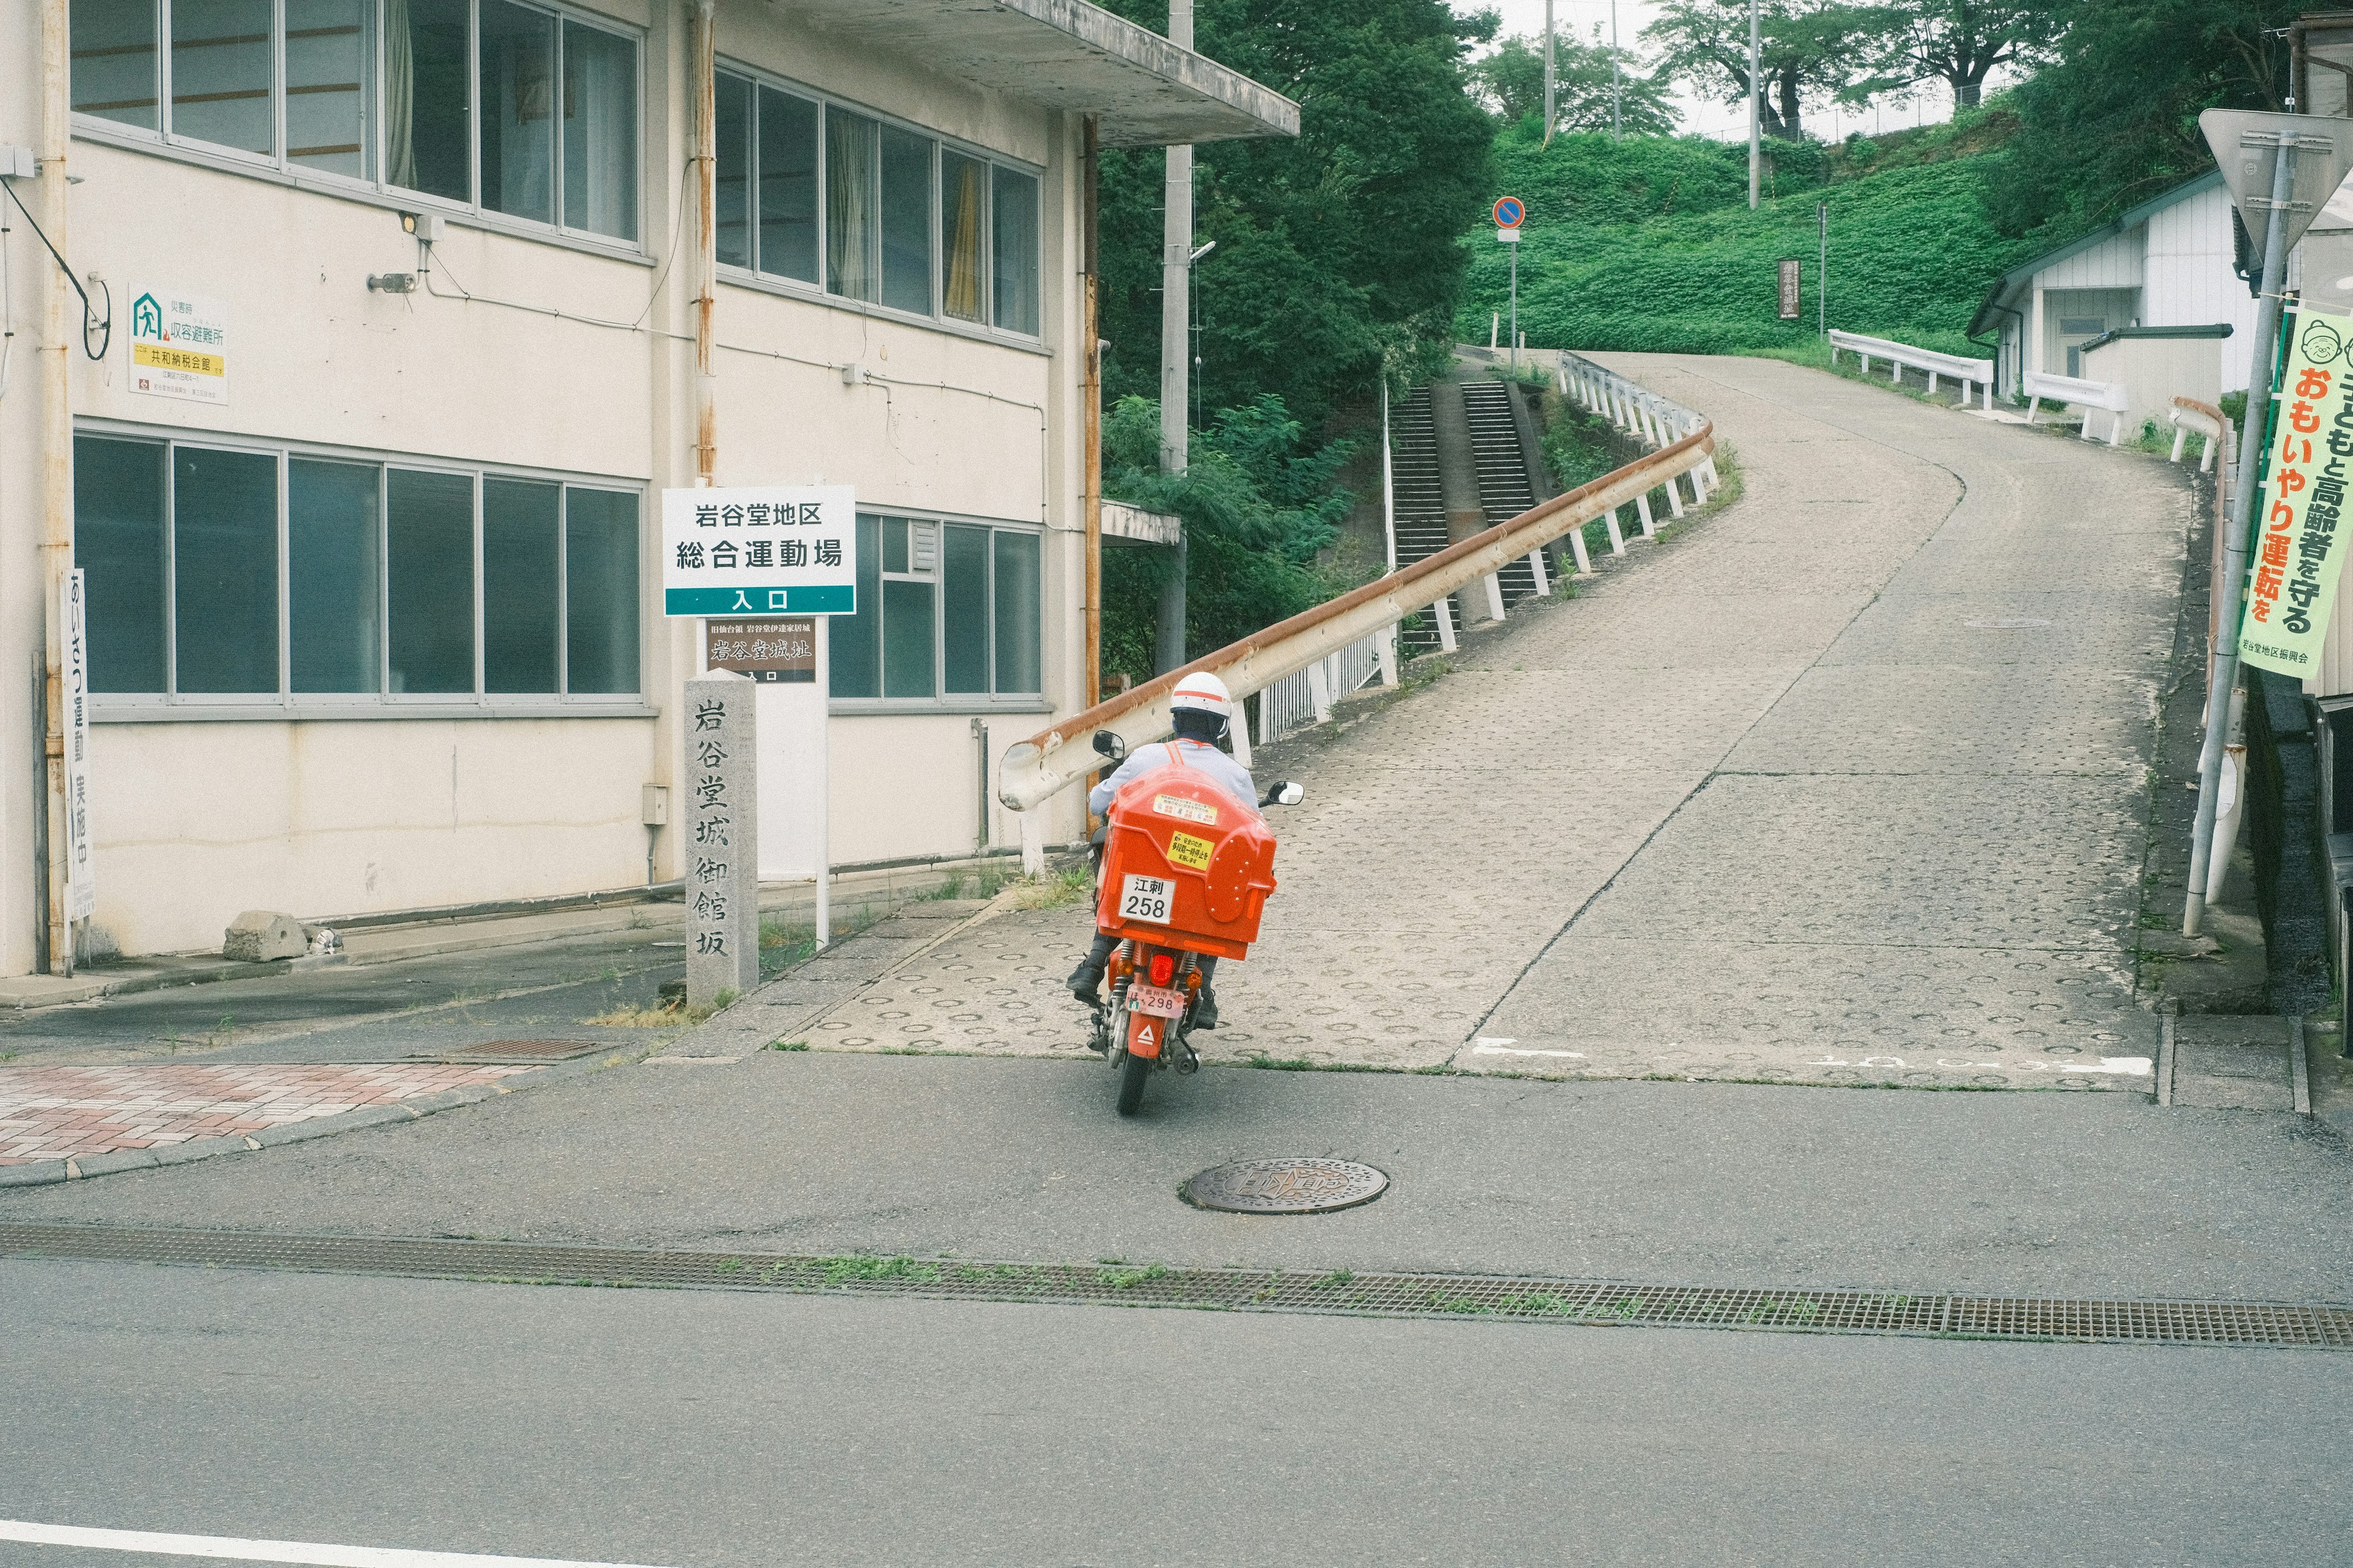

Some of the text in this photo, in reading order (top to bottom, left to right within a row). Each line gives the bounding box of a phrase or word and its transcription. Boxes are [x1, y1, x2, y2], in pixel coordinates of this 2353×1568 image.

[171, 300, 192, 315] 災害時
[170, 322, 223, 346] 収容避難所
[151, 349, 210, 371] 共和納税会館
[2251, 367, 2332, 623] おもいやり運転を
[695, 503, 822, 528] 岩谷堂地区
[676, 539, 842, 569] 総合運動場
[732, 590, 787, 610] 入口
[711, 624, 811, 634] 旧仙台領 岩谷堂伊達家居城
[711, 639, 812, 661] 岩谷堂城址
[2243, 638, 2308, 664] 岩谷堂地区振興会
[692, 699, 730, 958] 岩谷堂城御館坂
[1172, 842, 1208, 860] 多段階一時停止を
[1184, 838, 1202, 848] 安全のため
[1178, 854, 1197, 864] 実施します
[1134, 877, 1164, 896] 江刺
[1126, 895, 1165, 918] 258
[1146, 989, 1167, 998] 奥州市
